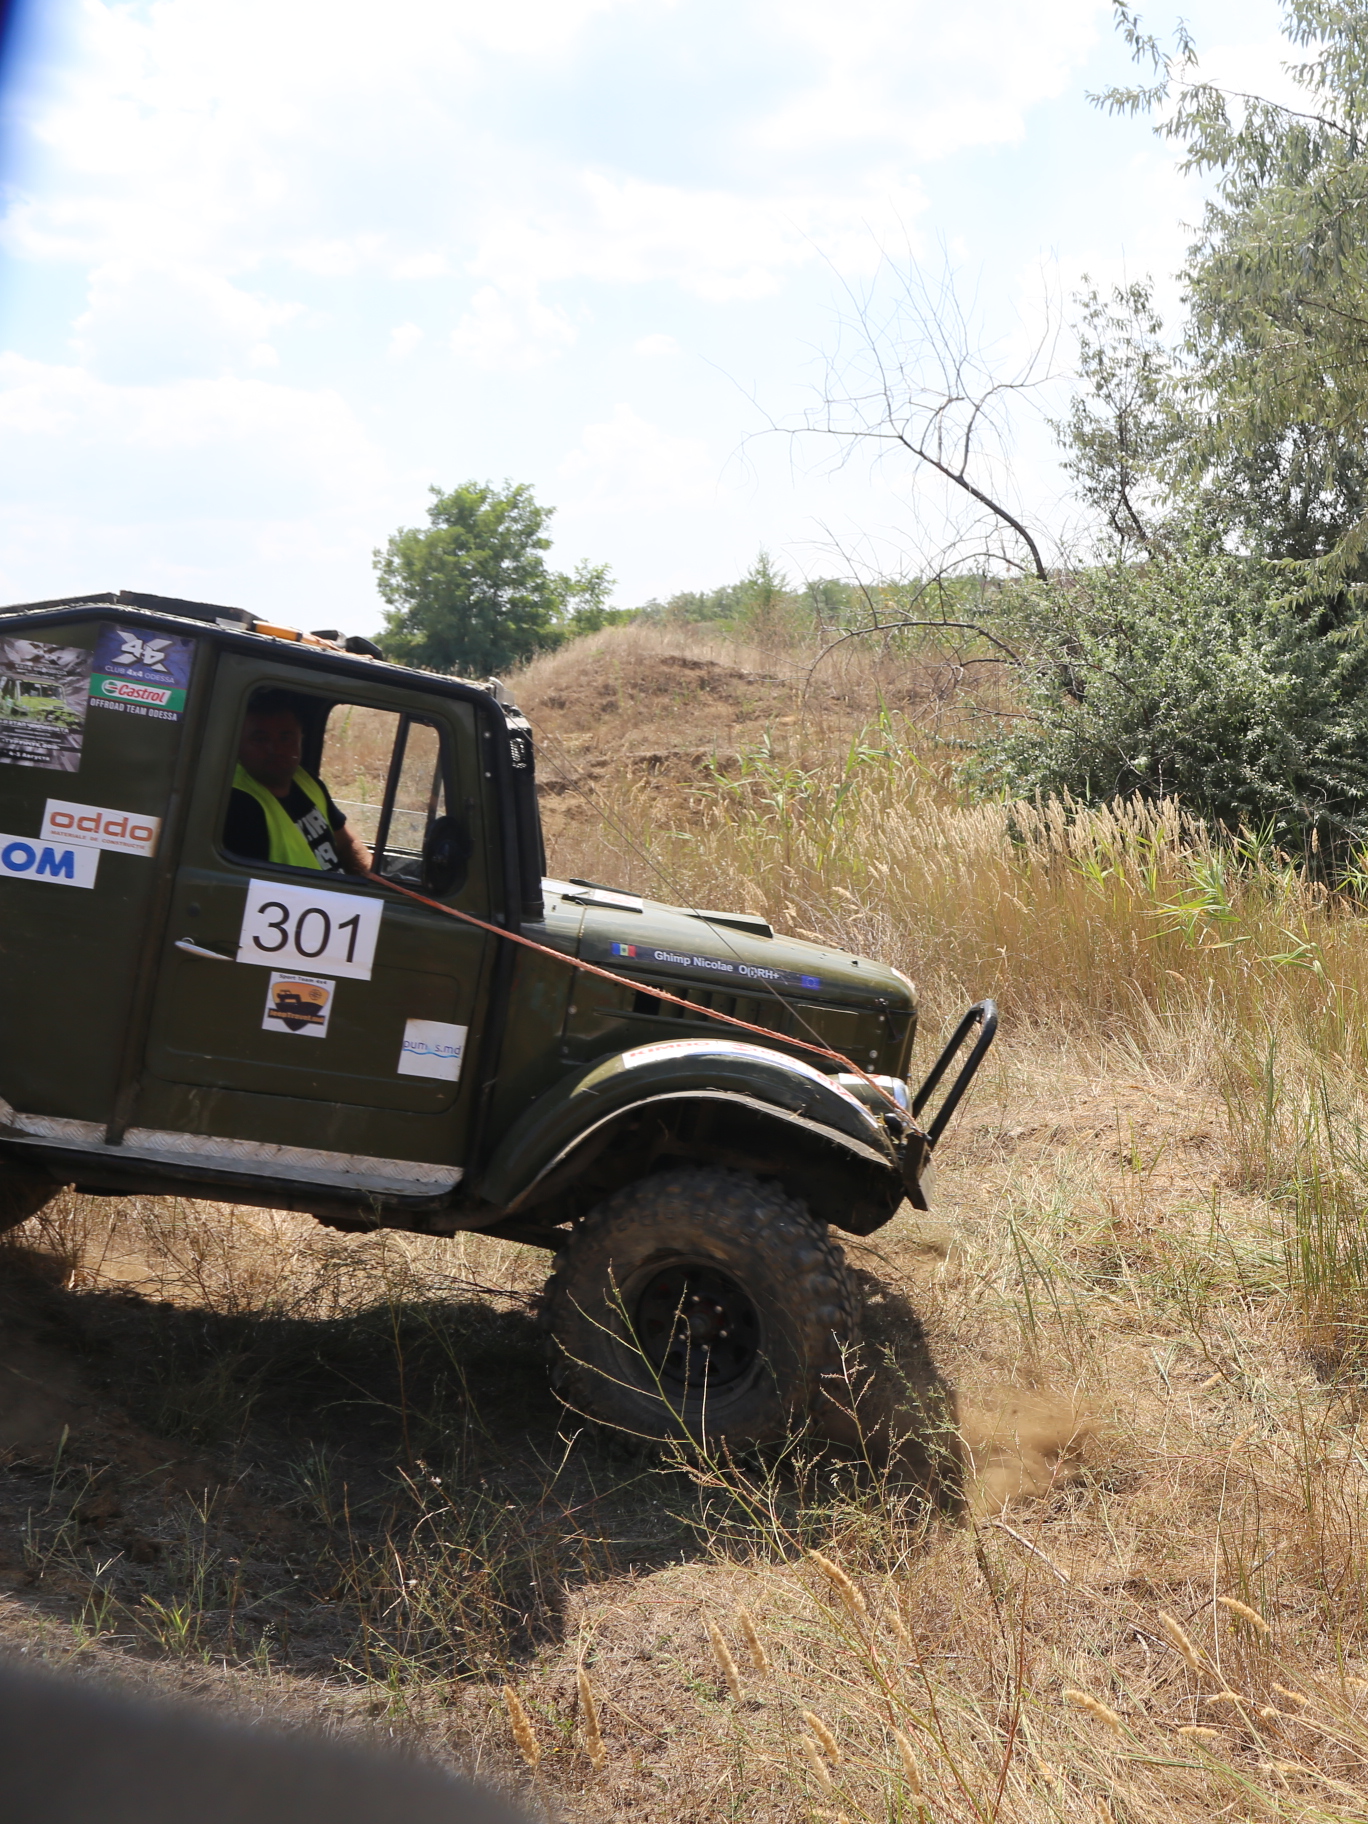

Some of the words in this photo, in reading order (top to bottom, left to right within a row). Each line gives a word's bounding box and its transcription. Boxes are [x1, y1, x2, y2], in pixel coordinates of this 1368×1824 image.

[105, 665, 125, 675] CLUB
[126, 669, 143, 678] 4x4
[144, 673, 175, 684] ODESSA
[118, 684, 166, 703] Castrol
[90, 698, 125, 712] OFFROAD
[126, 704, 147, 716] TEAM
[148, 708, 178, 721] ODESSA
[50, 811, 154, 842] oddo
[50, 830, 87, 841] MATERIALE
[1, 841, 75, 880] OM
[252, 901, 361, 963] 301
[654, 950, 691, 966] Ghimp
[693, 957, 733, 972] Nicolae
